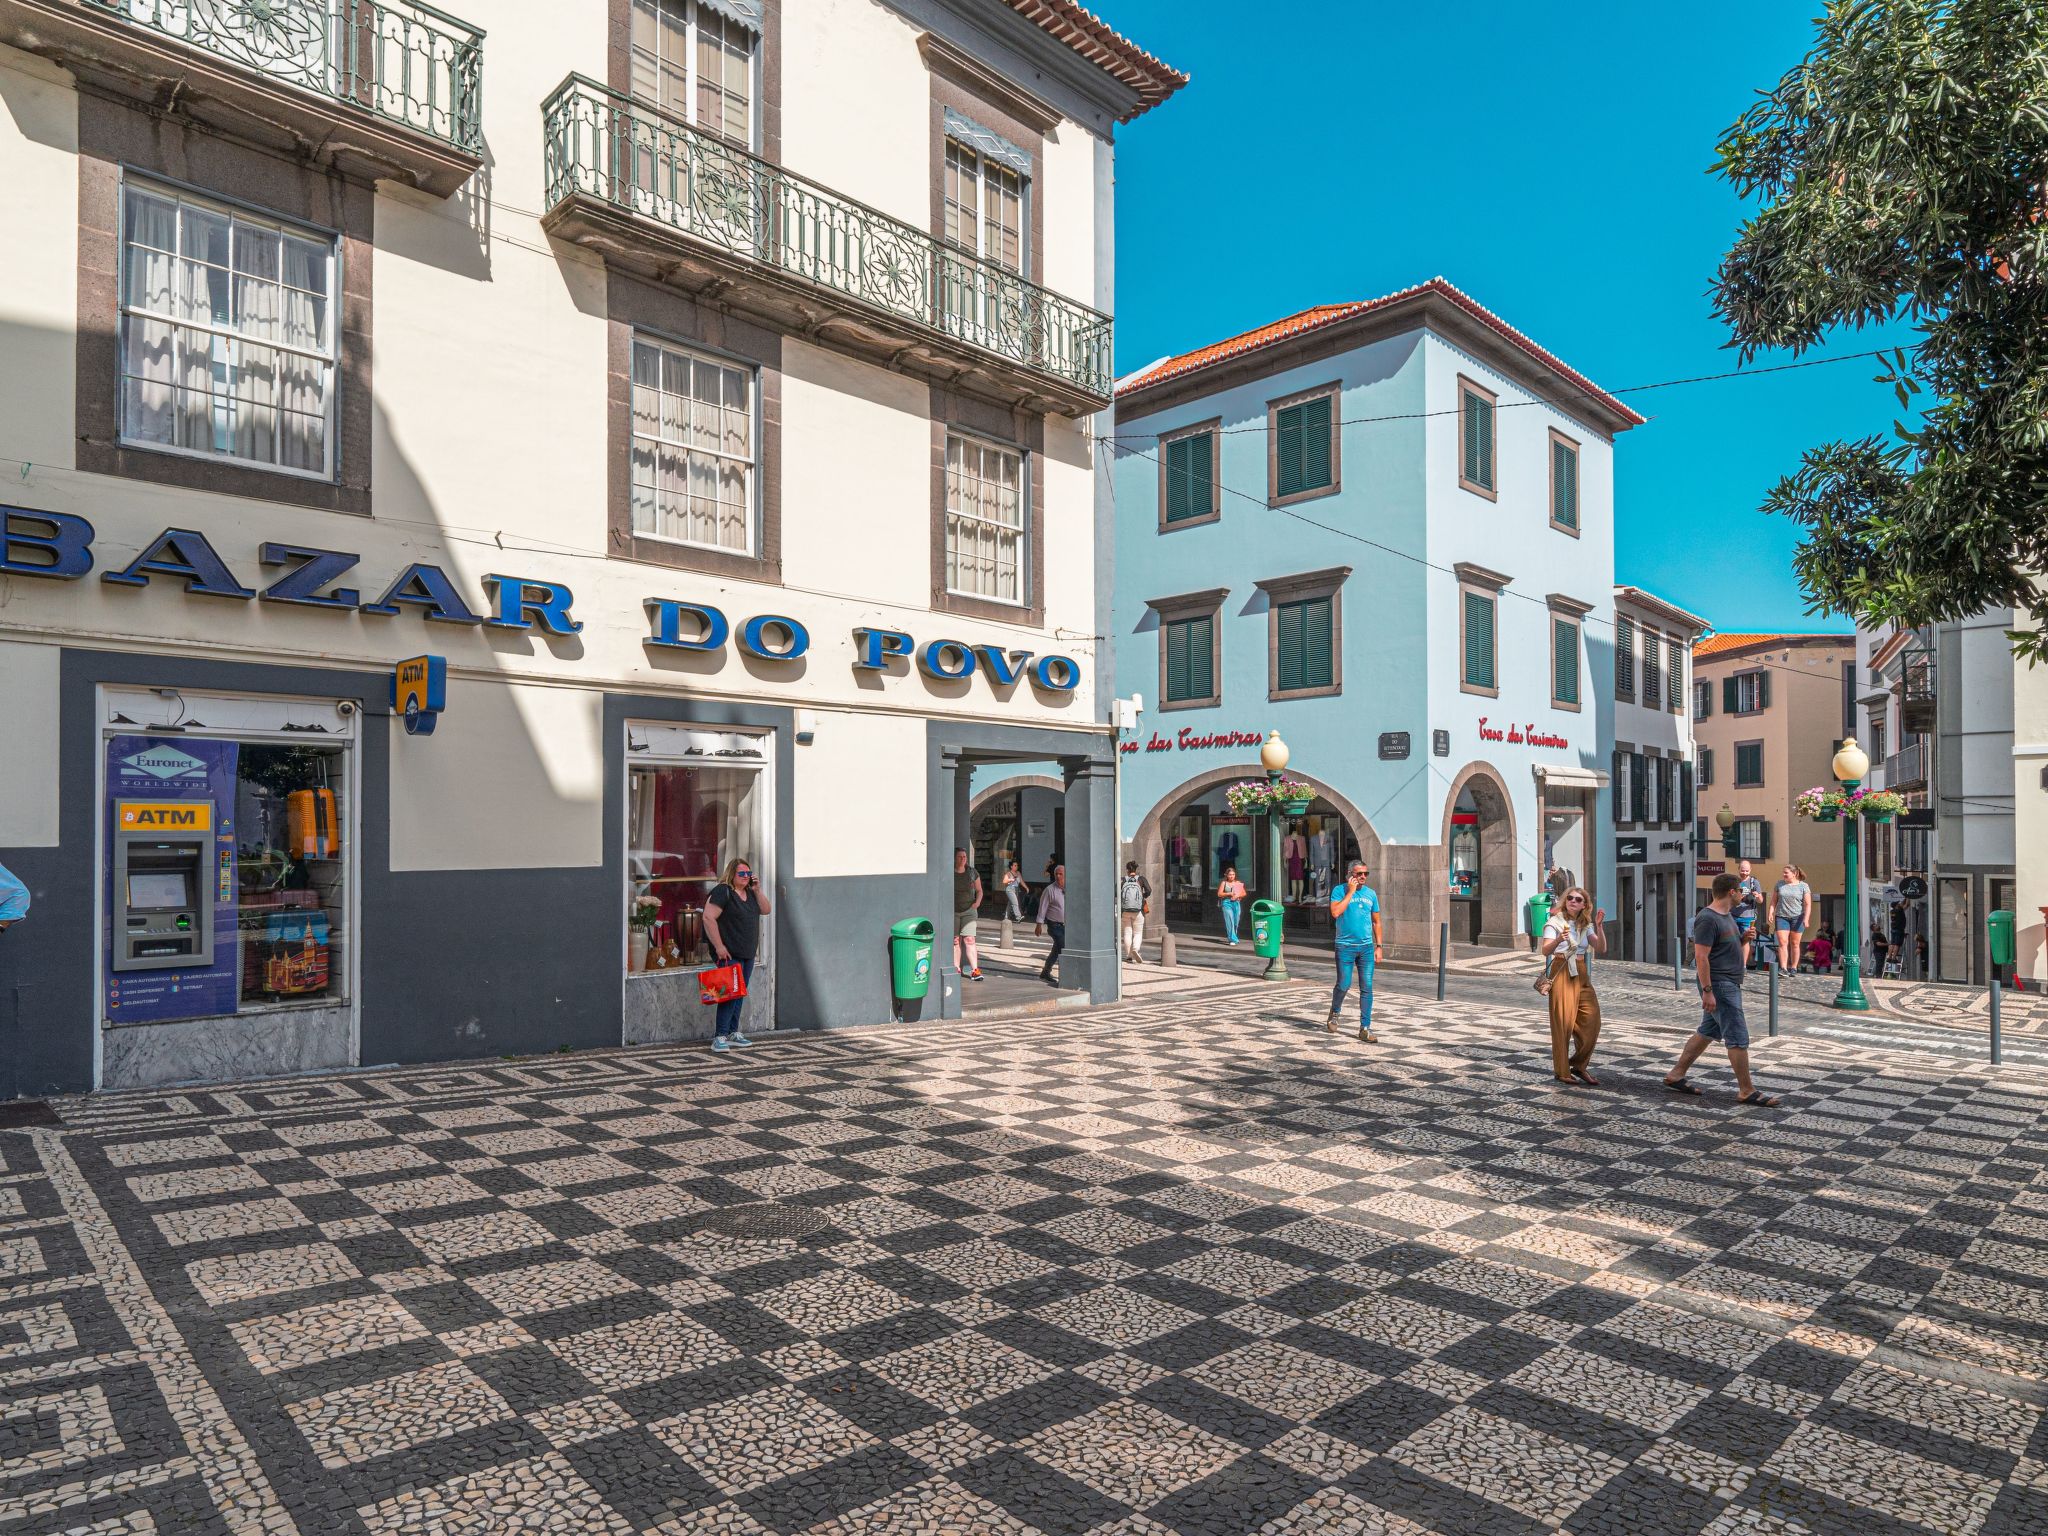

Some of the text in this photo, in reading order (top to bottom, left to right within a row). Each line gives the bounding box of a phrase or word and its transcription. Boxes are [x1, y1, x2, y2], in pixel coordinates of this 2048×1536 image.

[0, 504, 1082, 692] BAZAR DO POVO
[402, 664, 424, 684] ATM
[1146, 732, 1172, 752] das
[1178, 727, 1263, 750] Casimiras
[1478, 717, 1568, 749] Casa das Casimiras
[136, 755, 193, 768] Euronet
[121, 780, 208, 788] WORLDWIDE
[137, 809, 195, 825] ATM
